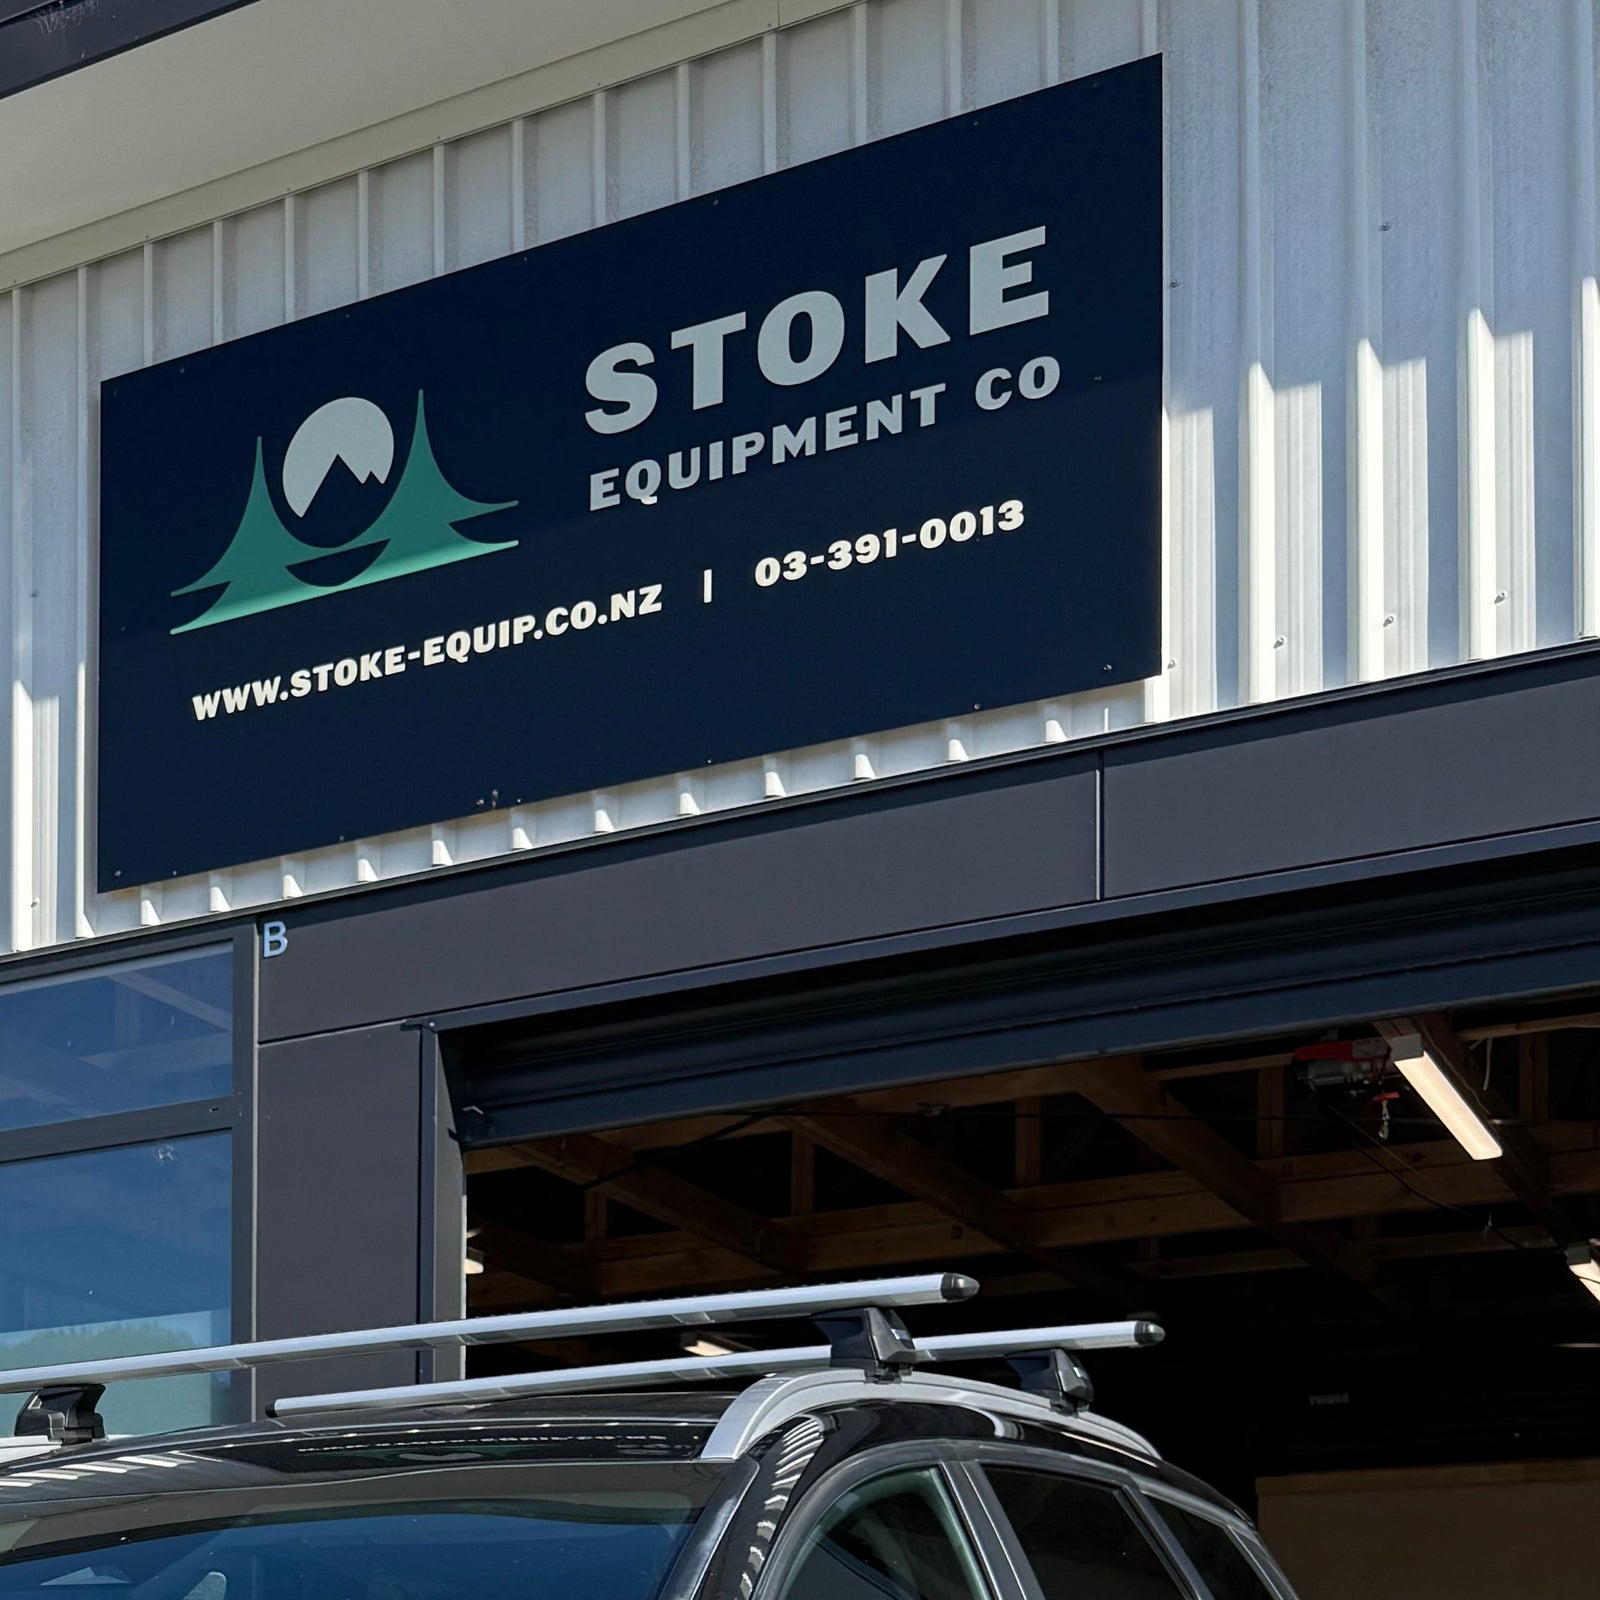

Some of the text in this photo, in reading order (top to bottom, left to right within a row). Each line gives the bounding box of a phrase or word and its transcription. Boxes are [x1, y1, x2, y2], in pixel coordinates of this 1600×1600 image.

[585, 225, 1049, 434] STOKE
[589, 356, 1060, 511] EQUIPMENT CO
[192, 583, 663, 721] WWW.STOKE-EQUIP.CO.NZ
[754, 499, 1025, 587] 03-391-0013
[263, 920, 288, 958] B
